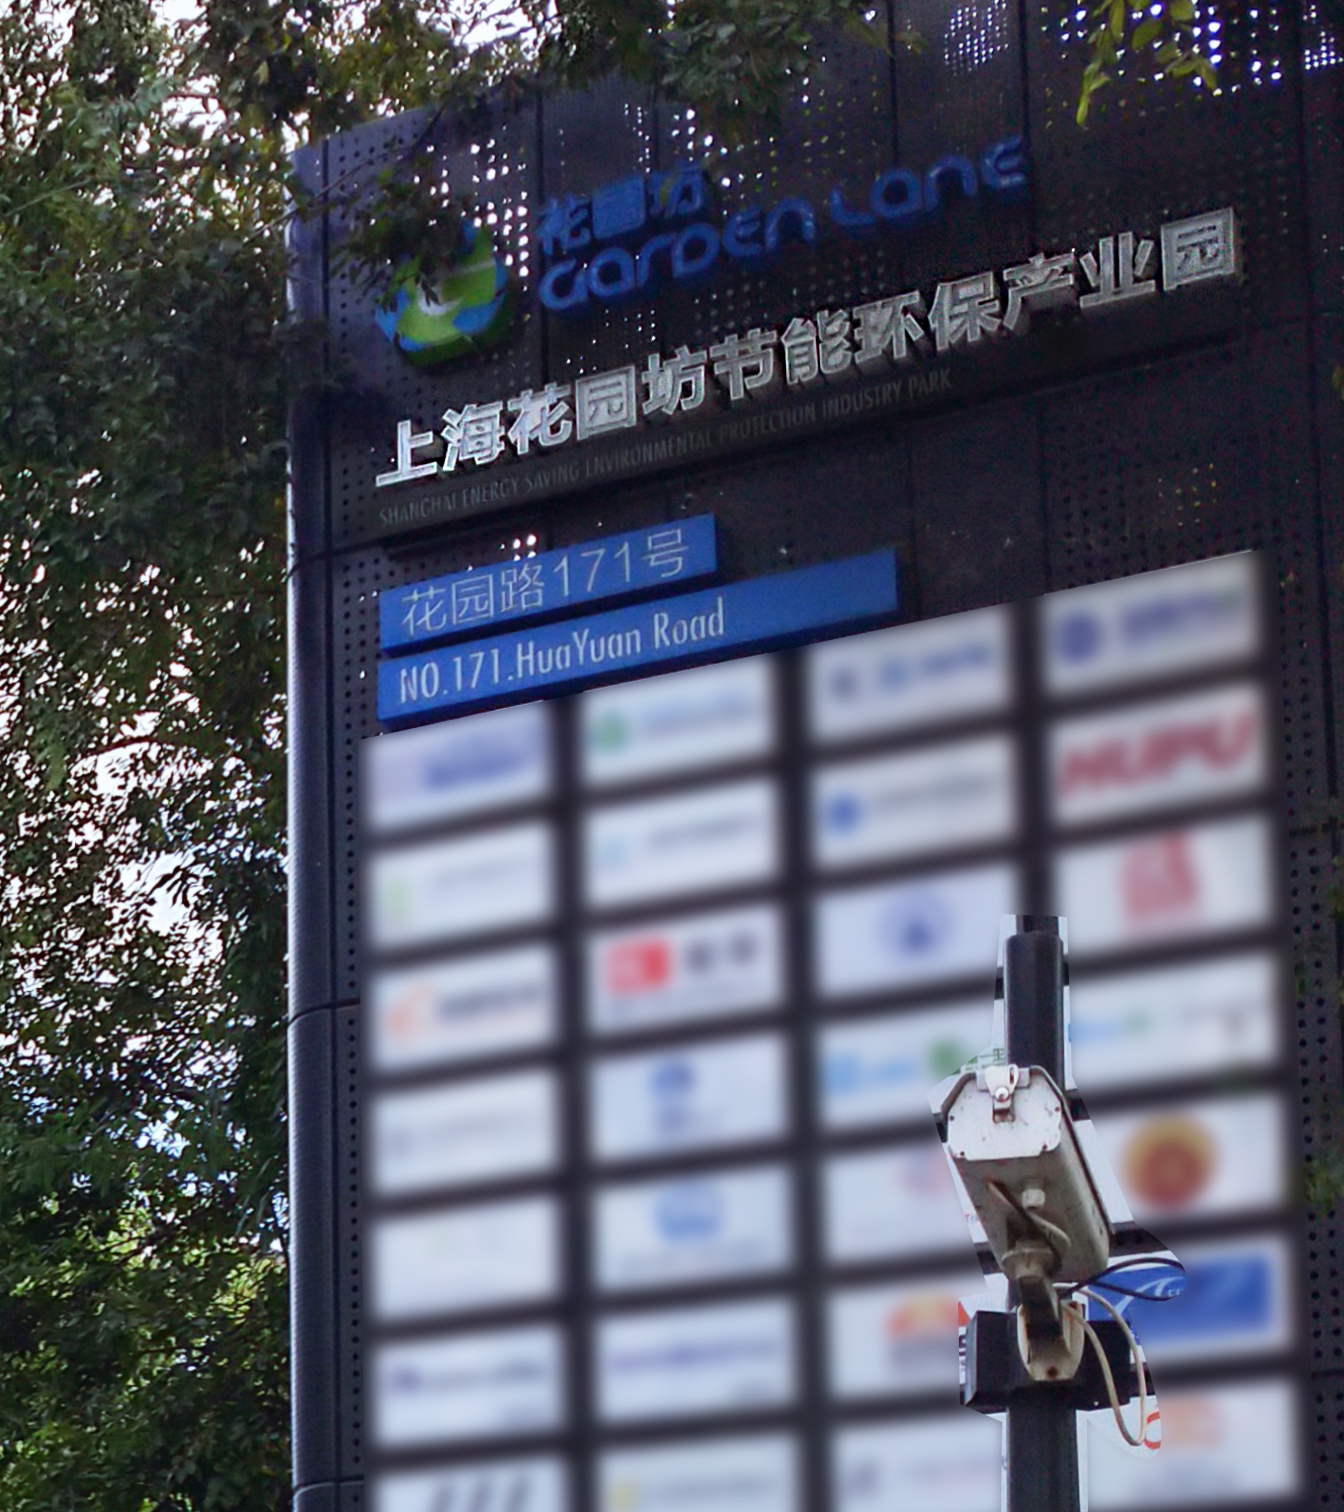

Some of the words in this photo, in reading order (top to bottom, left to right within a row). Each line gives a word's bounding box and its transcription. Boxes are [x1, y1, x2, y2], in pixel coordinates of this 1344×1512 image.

[374, 206, 1238, 488] 上海花园坊节能环保产业园
[378, 499, 459, 530] SHANGHAI
[461, 478, 521, 510] ENERGY
[525, 459, 582, 492] SAVING
[585, 430, 714, 479] ENVIRONMENTAL
[718, 401, 818, 446] PROTECTION
[821, 380, 904, 420] INDUSTRY
[907, 367, 953, 399] PARK
[401, 528, 691, 636] 花园路171号
[653, 598, 725, 649] Road
